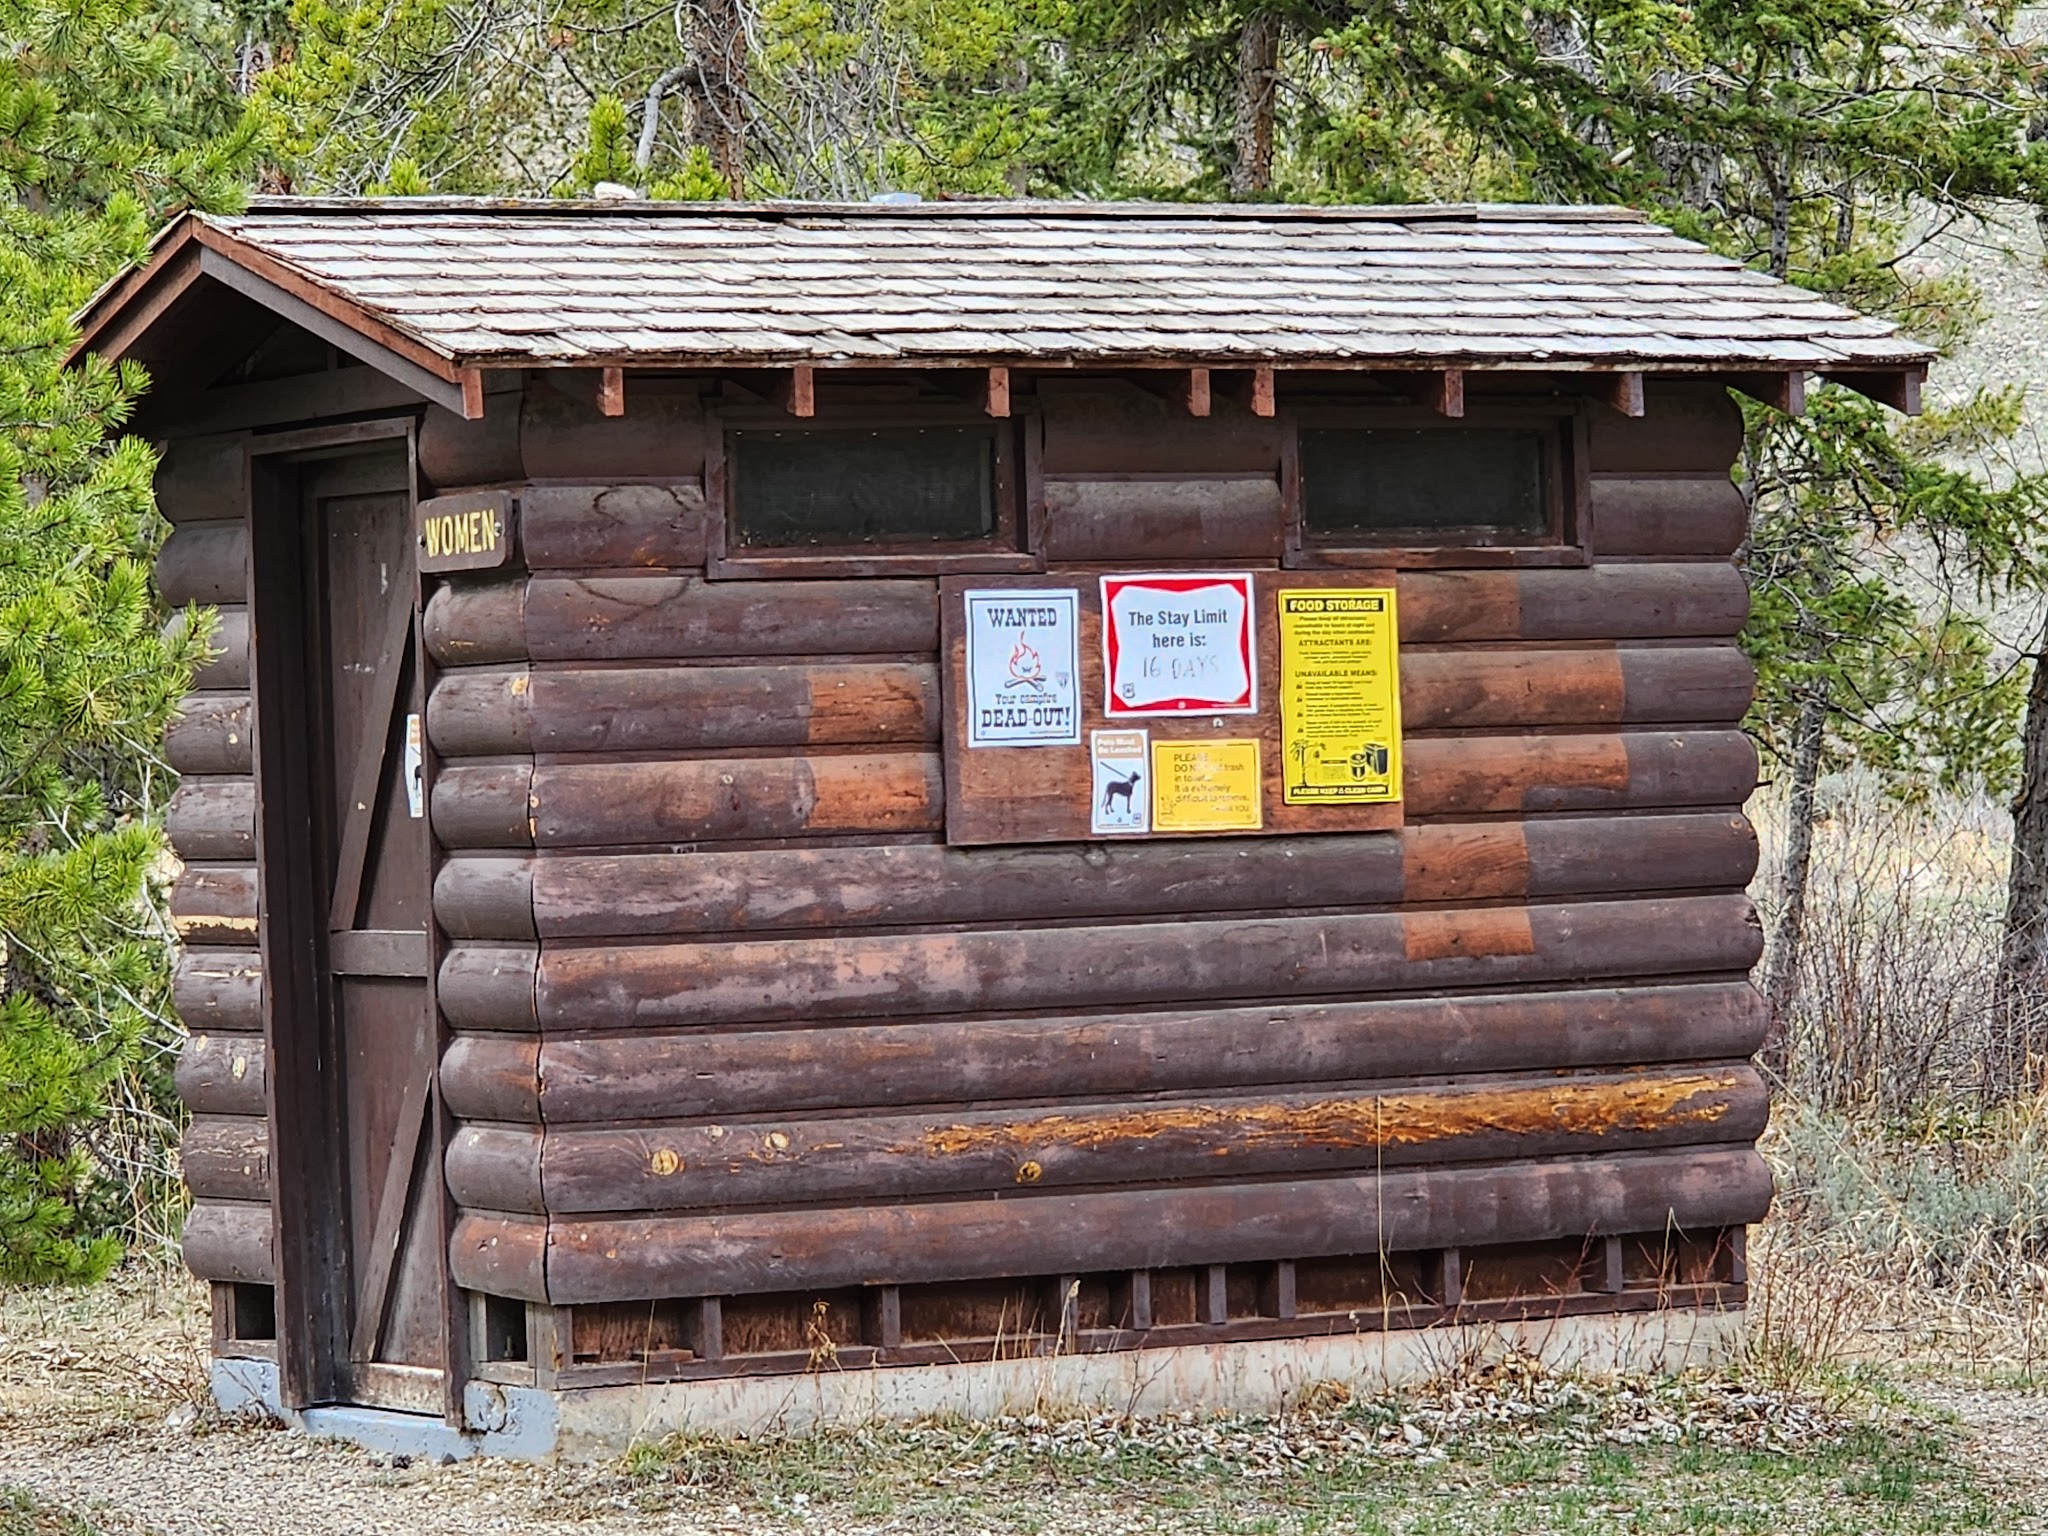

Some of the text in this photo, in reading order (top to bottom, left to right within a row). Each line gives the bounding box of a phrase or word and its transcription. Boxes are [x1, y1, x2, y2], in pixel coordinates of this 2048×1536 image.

[425, 508, 495, 558] WOMEN
[1289, 599, 1380, 612] FOOD STORAGE
[987, 607, 1057, 628] WANTED
[1128, 608, 1228, 628] The Stay Limit
[1152, 632, 1207, 648] here is:
[1298, 639, 1354, 647] ATTRACTANTS
[1143, 655, 1220, 680] 16 DAYS
[1294, 670, 1348, 678] UNAVAILABLE
[995, 693, 1016, 705] Your
[981, 707, 1071, 728] DEAD-OUT!
[1174, 763, 1188, 773] DO
